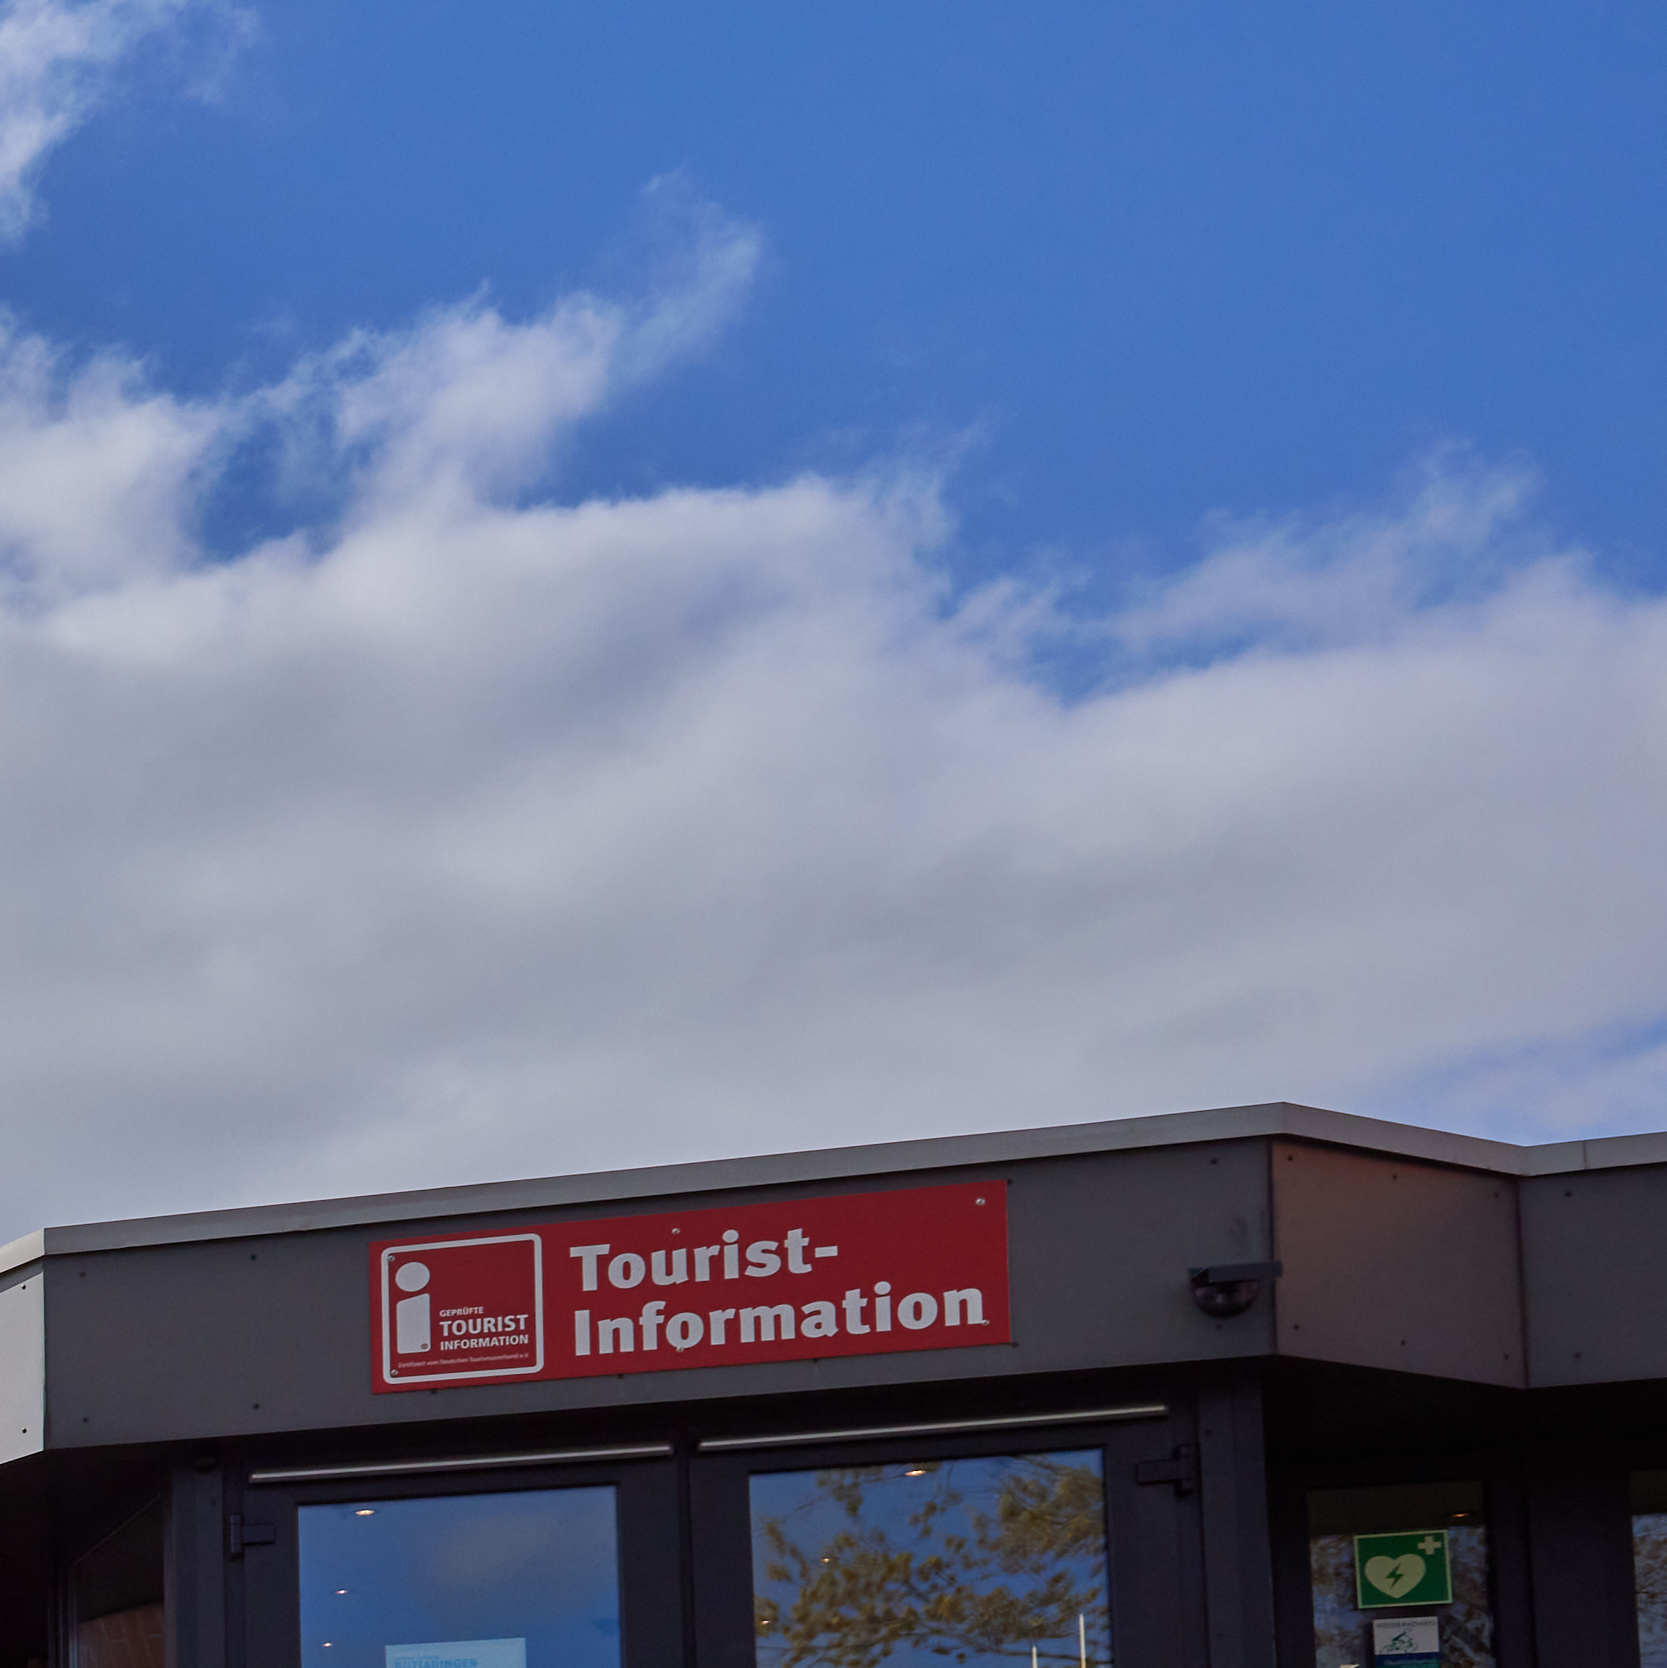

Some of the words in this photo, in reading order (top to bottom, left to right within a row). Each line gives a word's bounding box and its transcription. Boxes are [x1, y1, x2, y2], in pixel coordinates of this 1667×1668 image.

[569, 1228, 839, 1292] Tourist-
[439, 1306, 484, 1318] GEPRÜFTE
[574, 1280, 986, 1357] Information
[439, 1314, 529, 1337] TOURIST
[440, 1334, 529, 1352] INFORMATION
